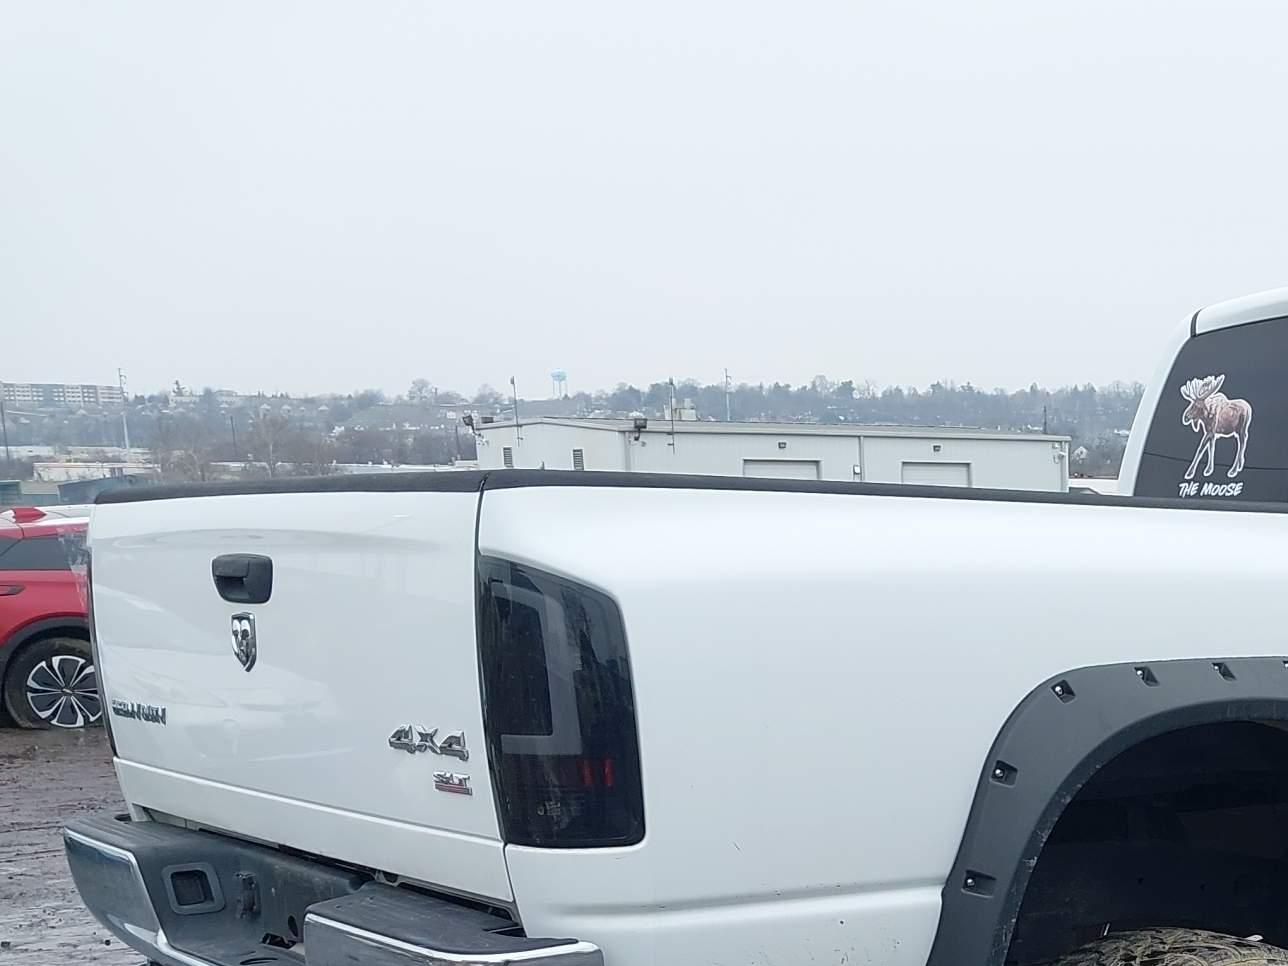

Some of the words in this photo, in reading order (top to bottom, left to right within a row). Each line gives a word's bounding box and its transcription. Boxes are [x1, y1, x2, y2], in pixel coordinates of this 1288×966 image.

[1179, 481, 1199, 498] THE
[1200, 482, 1243, 497] MOOSE
[432, 771, 472, 794] SLT
